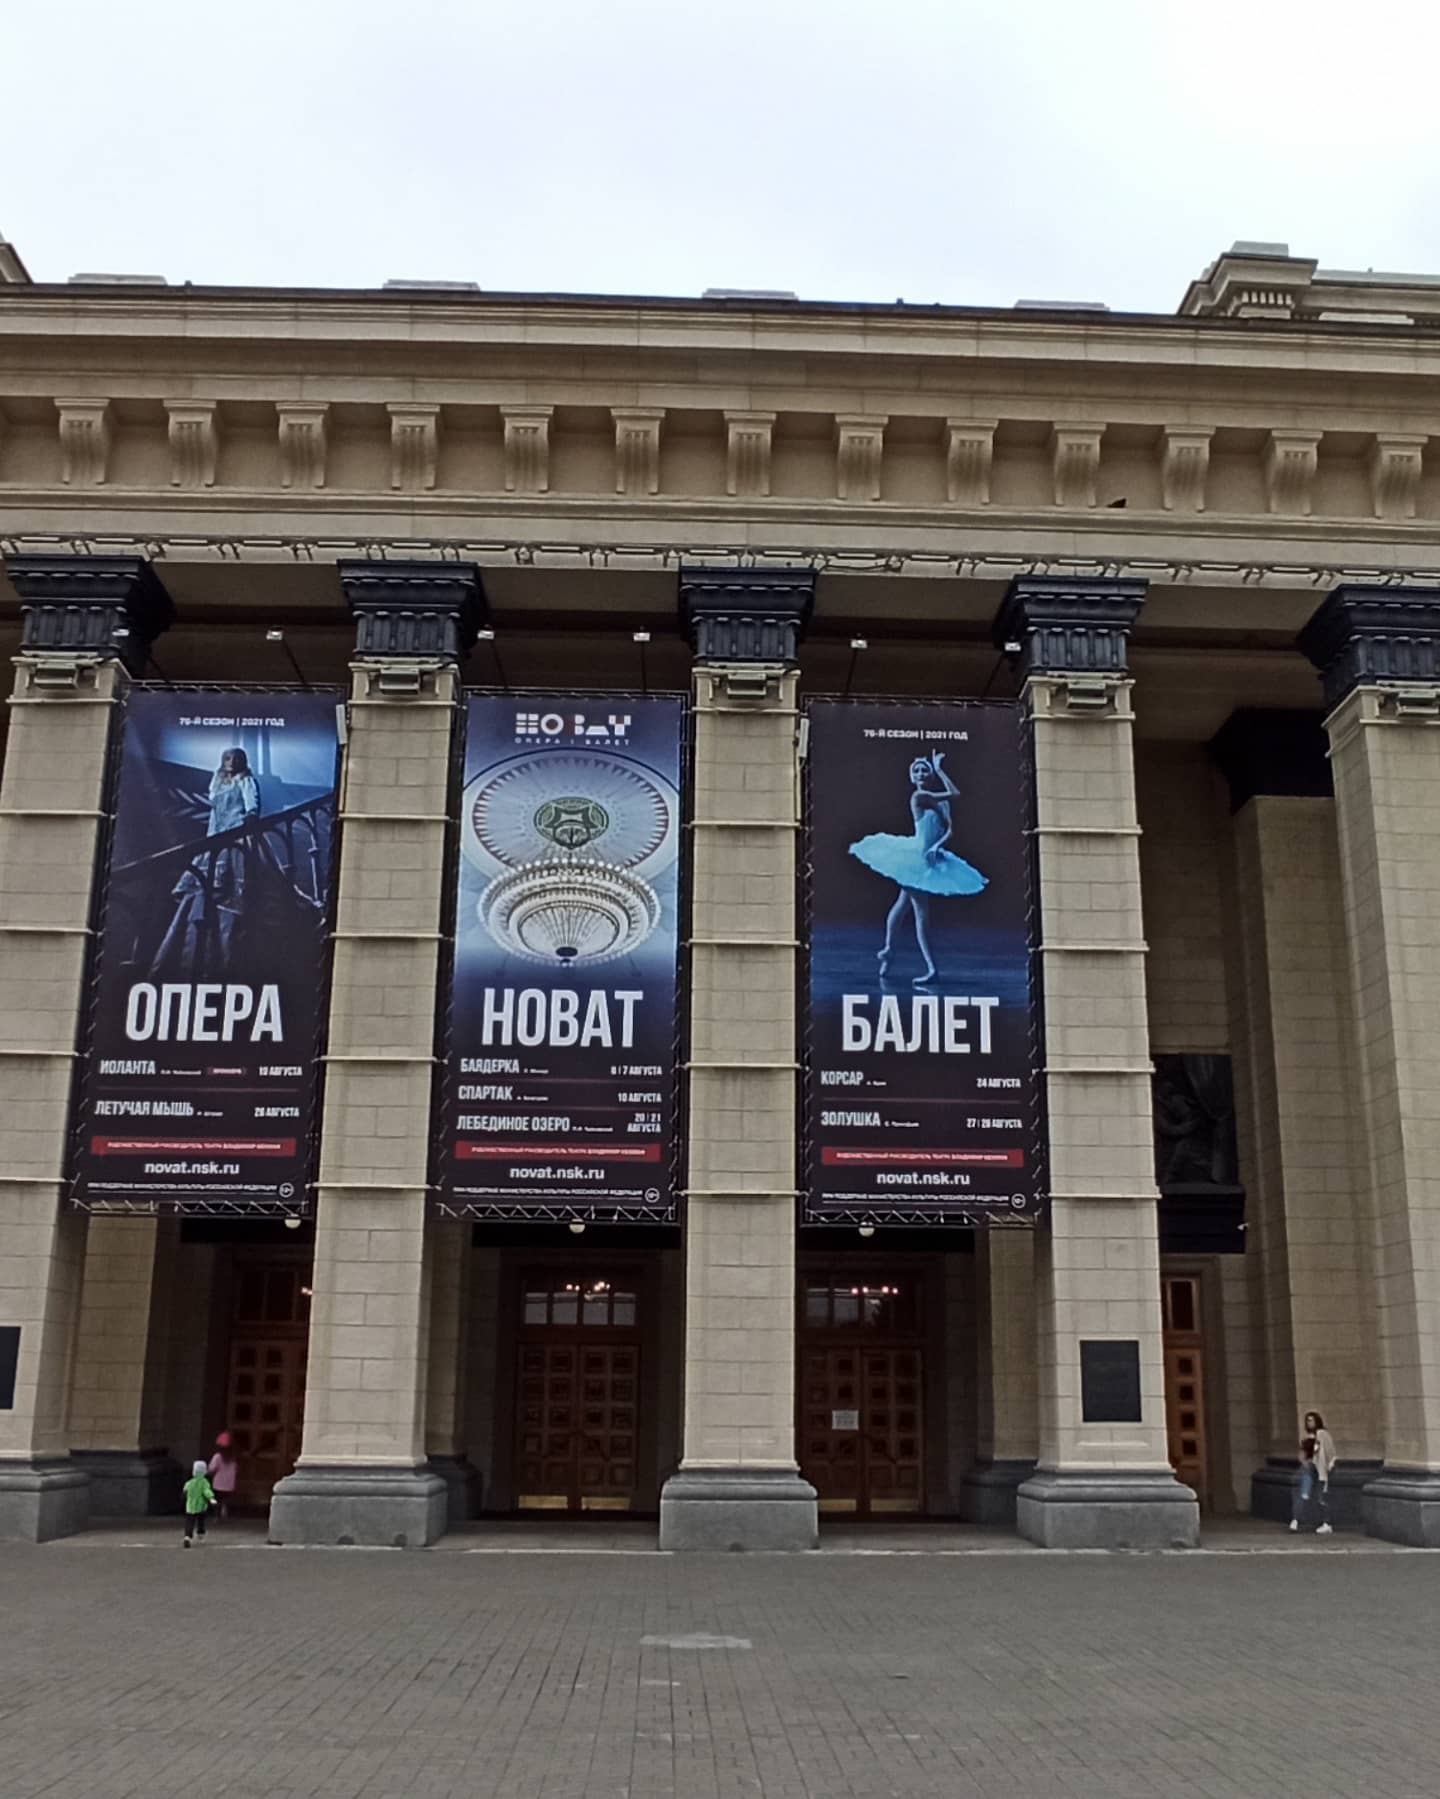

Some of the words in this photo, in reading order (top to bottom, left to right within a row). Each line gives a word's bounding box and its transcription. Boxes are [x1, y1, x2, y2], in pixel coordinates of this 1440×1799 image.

[926, 731, 946, 739] 2021
[949, 731, 968, 741] ГОД
[126, 983, 284, 1041] ОПЕРА
[482, 988, 643, 1047] НОВАТ
[843, 994, 999, 1053] БАЛЕТ
[100, 1060, 155, 1074] ИОЛАНТА
[461, 1058, 519, 1073] БАЯДЕРКА
[821, 1071, 863, 1085] КОРСАР
[459, 1086, 512, 1100] СПАРТАК
[94, 1101, 150, 1115] ЛЕТУЧАЯ
[152, 1102, 193, 1116] МЫШЬ
[456, 1116, 529, 1131] ЛЕБЕДИНОЕ
[532, 1117, 570, 1131] ОЗЕРО
[821, 1111, 880, 1126] ЗОЛУШКА
[145, 1162, 239, 1174] novat.nsk.ru
[510, 1167, 604, 1179] novat.nsk.ru
[877, 1172, 970, 1184] novat.nsk.ru
